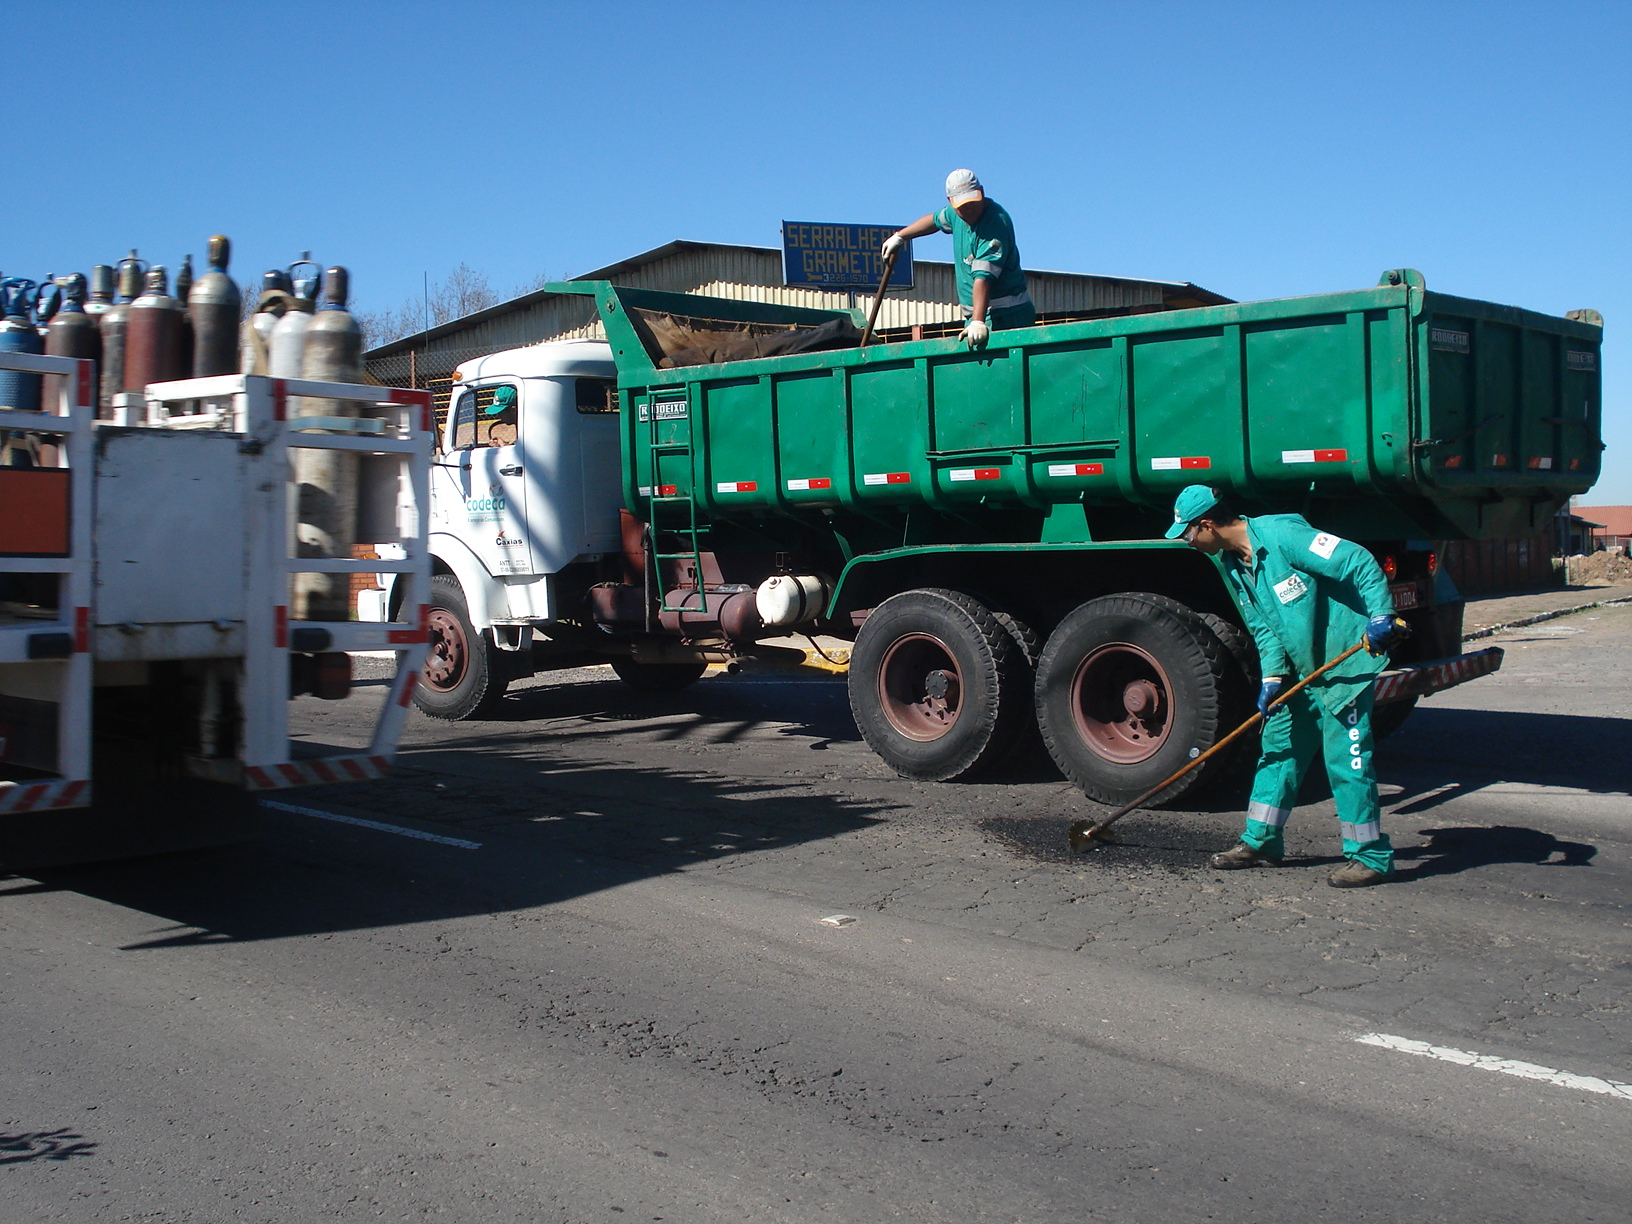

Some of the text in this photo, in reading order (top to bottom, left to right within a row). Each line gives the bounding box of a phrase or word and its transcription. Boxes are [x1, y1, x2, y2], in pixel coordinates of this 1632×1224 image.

[787, 225, 908, 251] SERRALHER
[802, 250, 895, 274] GRAMETA
[466, 494, 506, 511] codeca
[496, 538, 523, 546] Caxias
[1394, 591, 1417, 607] J-1004
[1346, 699, 1362, 770] deca
